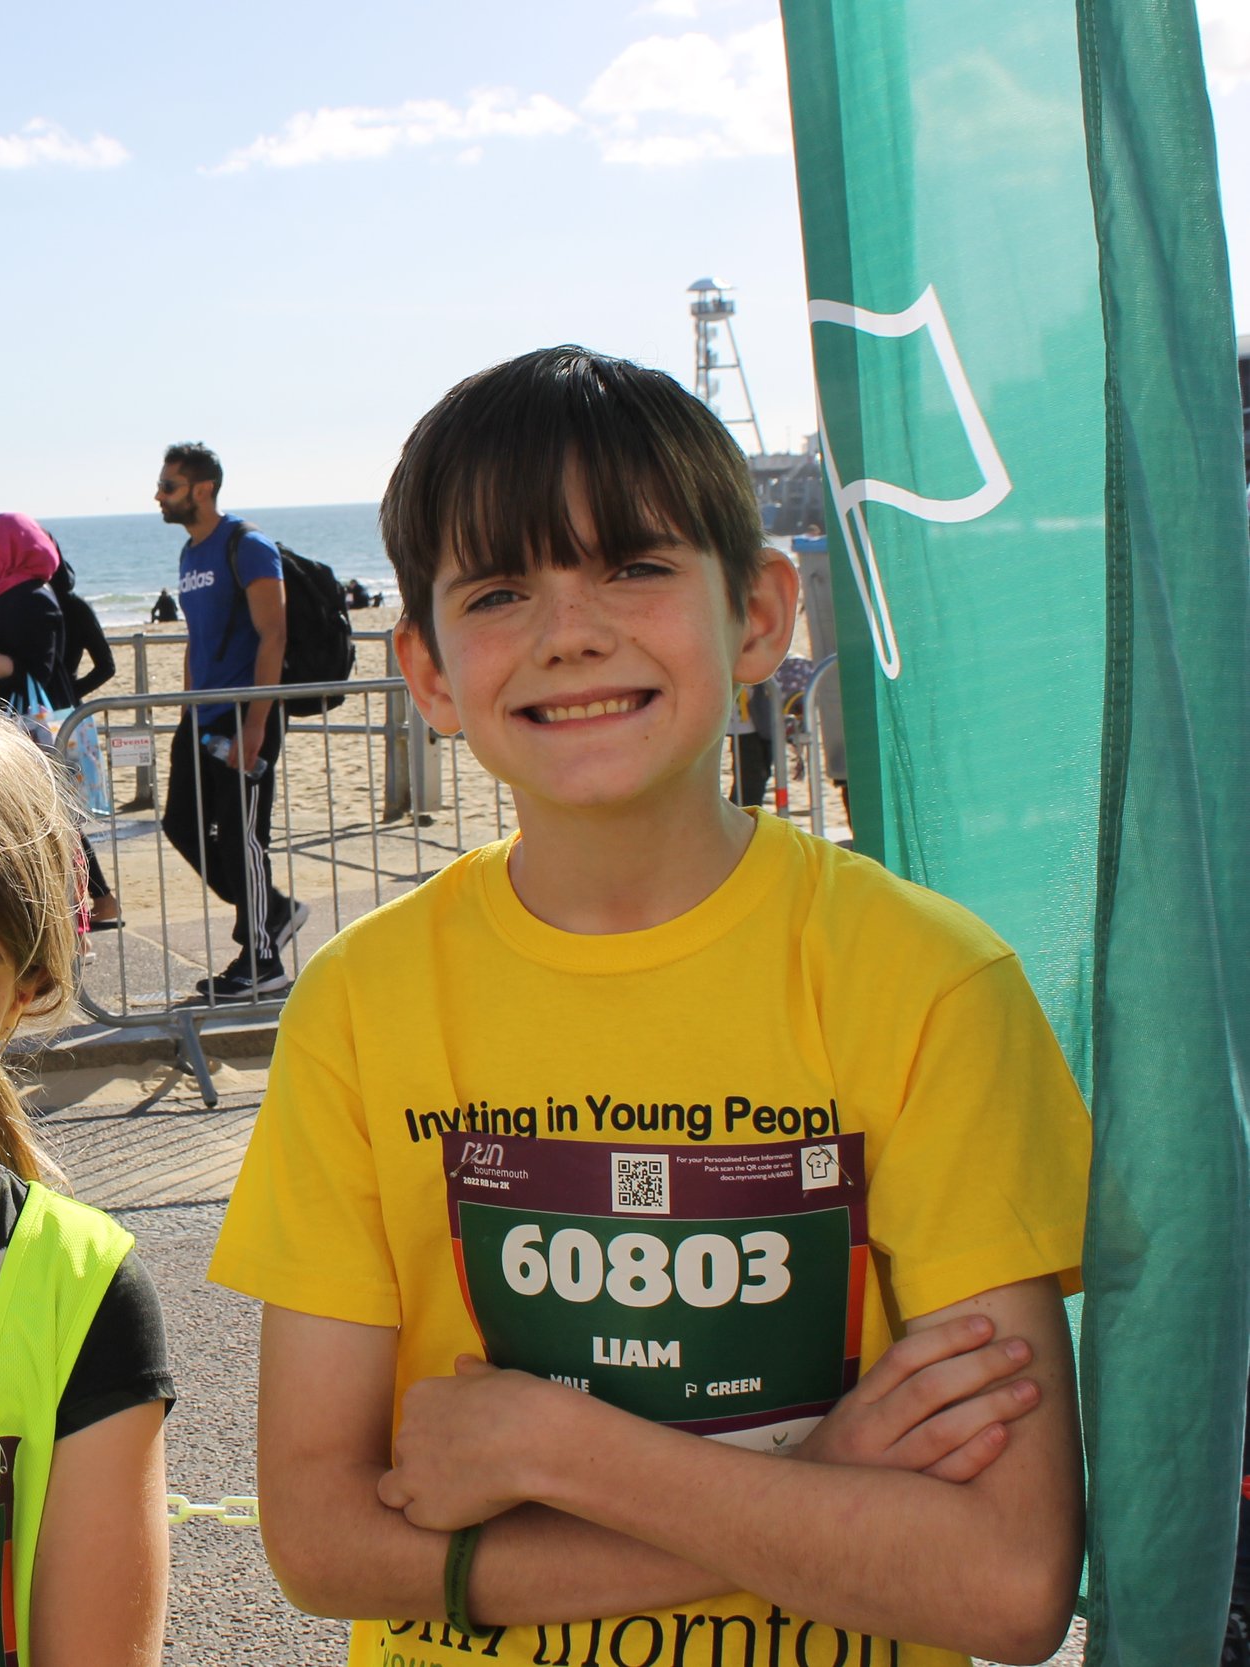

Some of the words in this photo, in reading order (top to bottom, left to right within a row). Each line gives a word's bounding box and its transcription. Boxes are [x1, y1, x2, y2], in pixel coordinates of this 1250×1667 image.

[547, 1096, 579, 1133] in
[584, 1094, 713, 1142] Young
[461, 1141, 504, 1166] run
[761, 1153, 793, 1161] Information
[815, 1160, 822, 1169] 2
[463, 1176, 479, 1186] 2022
[474, 1165, 529, 1179] bournemouth
[501, 1224, 792, 1308] 60803
[592, 1336, 680, 1368] LIAM
[550, 1373, 590, 1393] MALE
[706, 1377, 761, 1397] GREEN
